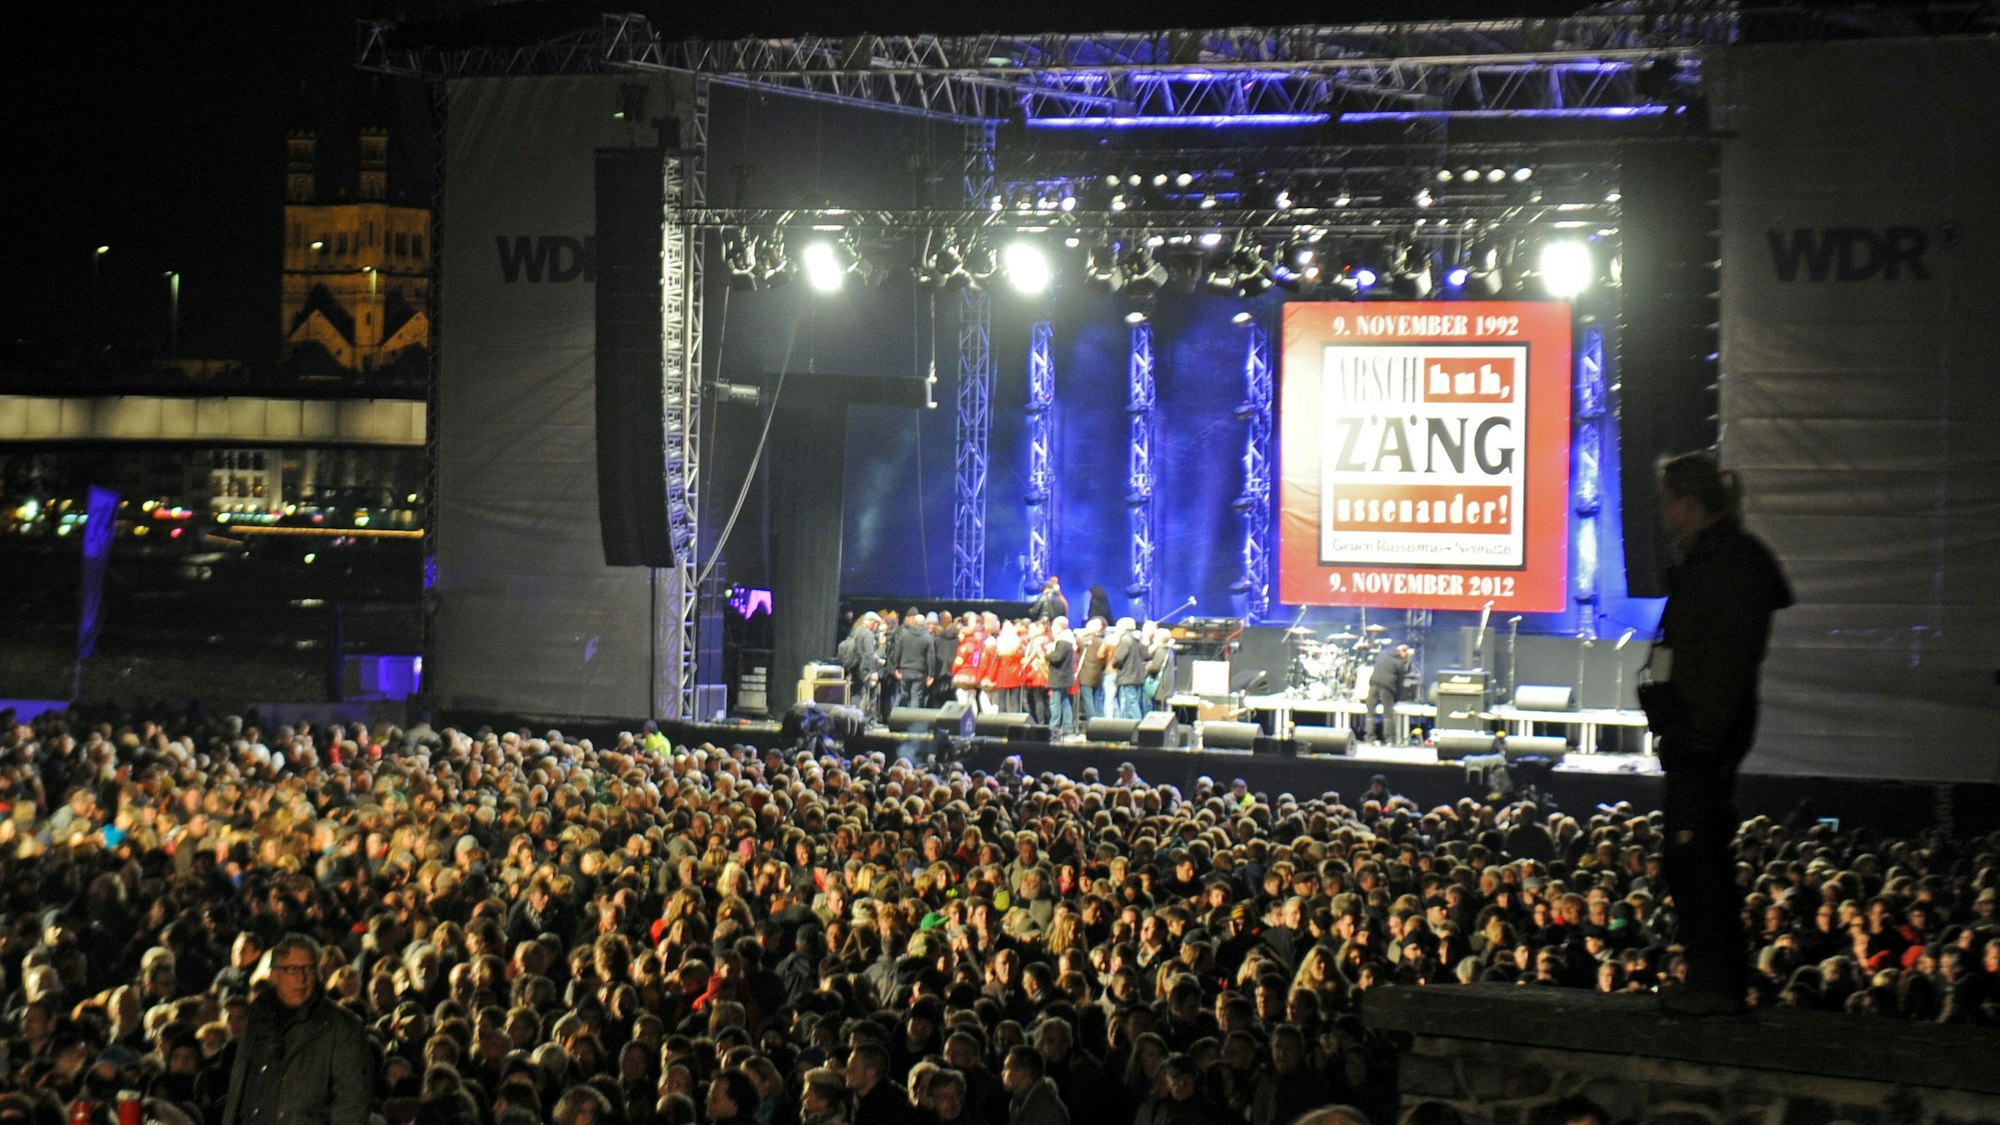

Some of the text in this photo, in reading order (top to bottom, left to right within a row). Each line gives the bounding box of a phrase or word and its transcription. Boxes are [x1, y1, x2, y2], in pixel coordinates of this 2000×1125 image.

[1333, 315, 1519, 337] 9. NOVEMBER 1992
[1429, 363, 1511, 400] huh,
[1333, 414, 1515, 476] ZÄNG
[1337, 492, 1509, 525] ussenander!
[1329, 571, 1515, 597] 9. NOVEMBER 2012
